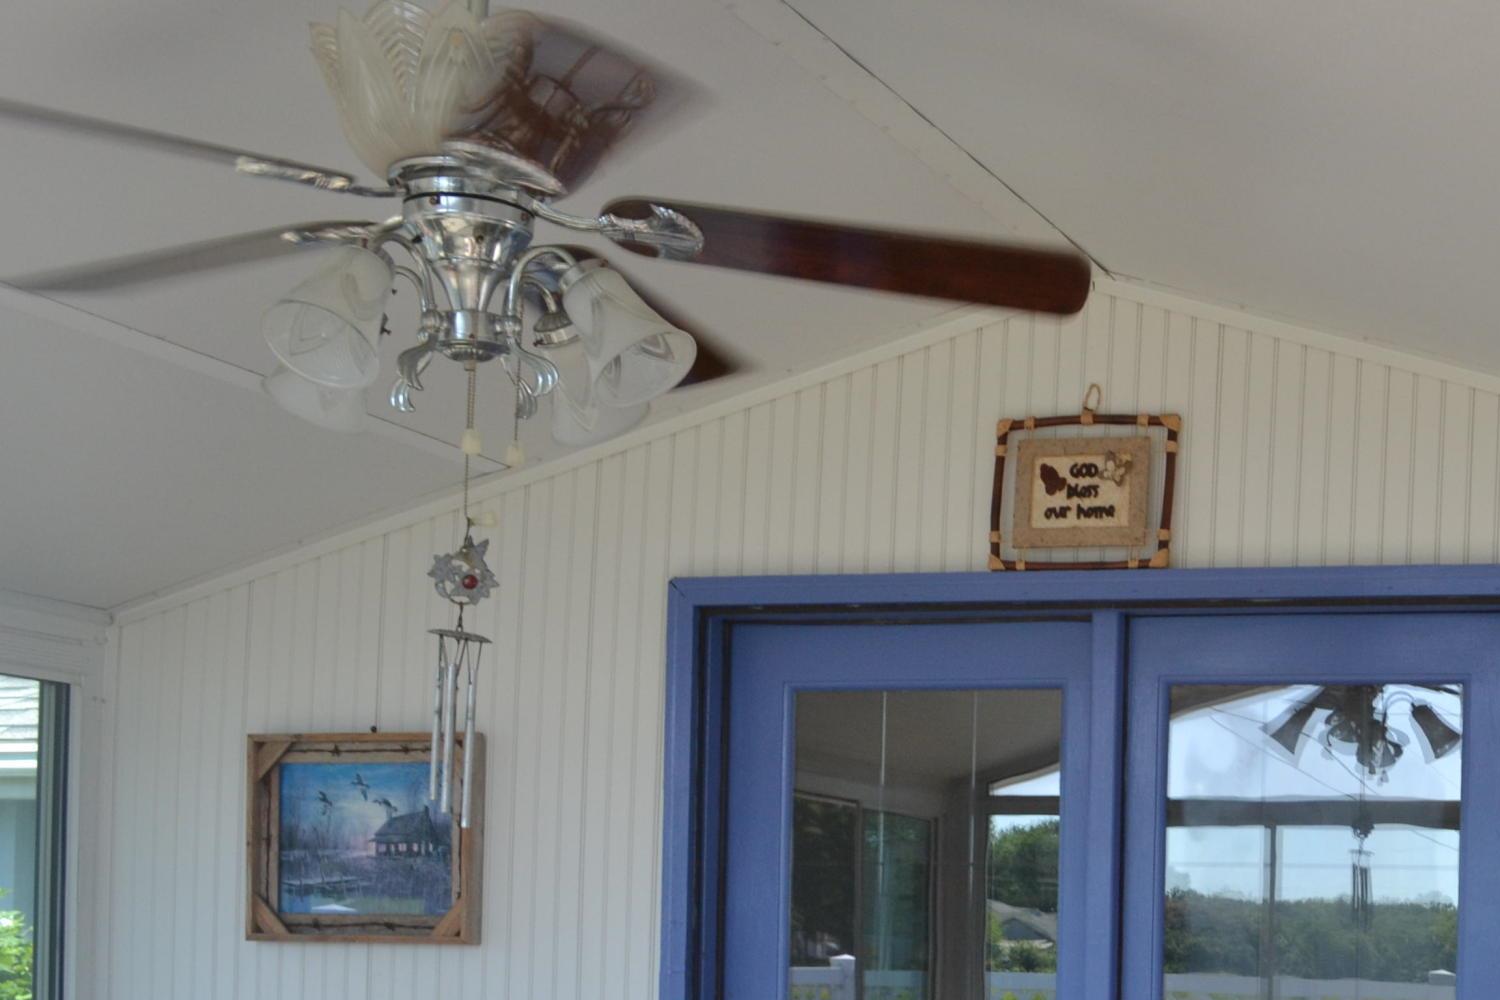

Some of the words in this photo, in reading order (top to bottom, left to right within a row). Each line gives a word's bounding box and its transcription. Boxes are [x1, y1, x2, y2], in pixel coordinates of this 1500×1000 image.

[1069, 462, 1100, 479] GOD
[1044, 505, 1072, 520] our
[1076, 503, 1116, 520] home
